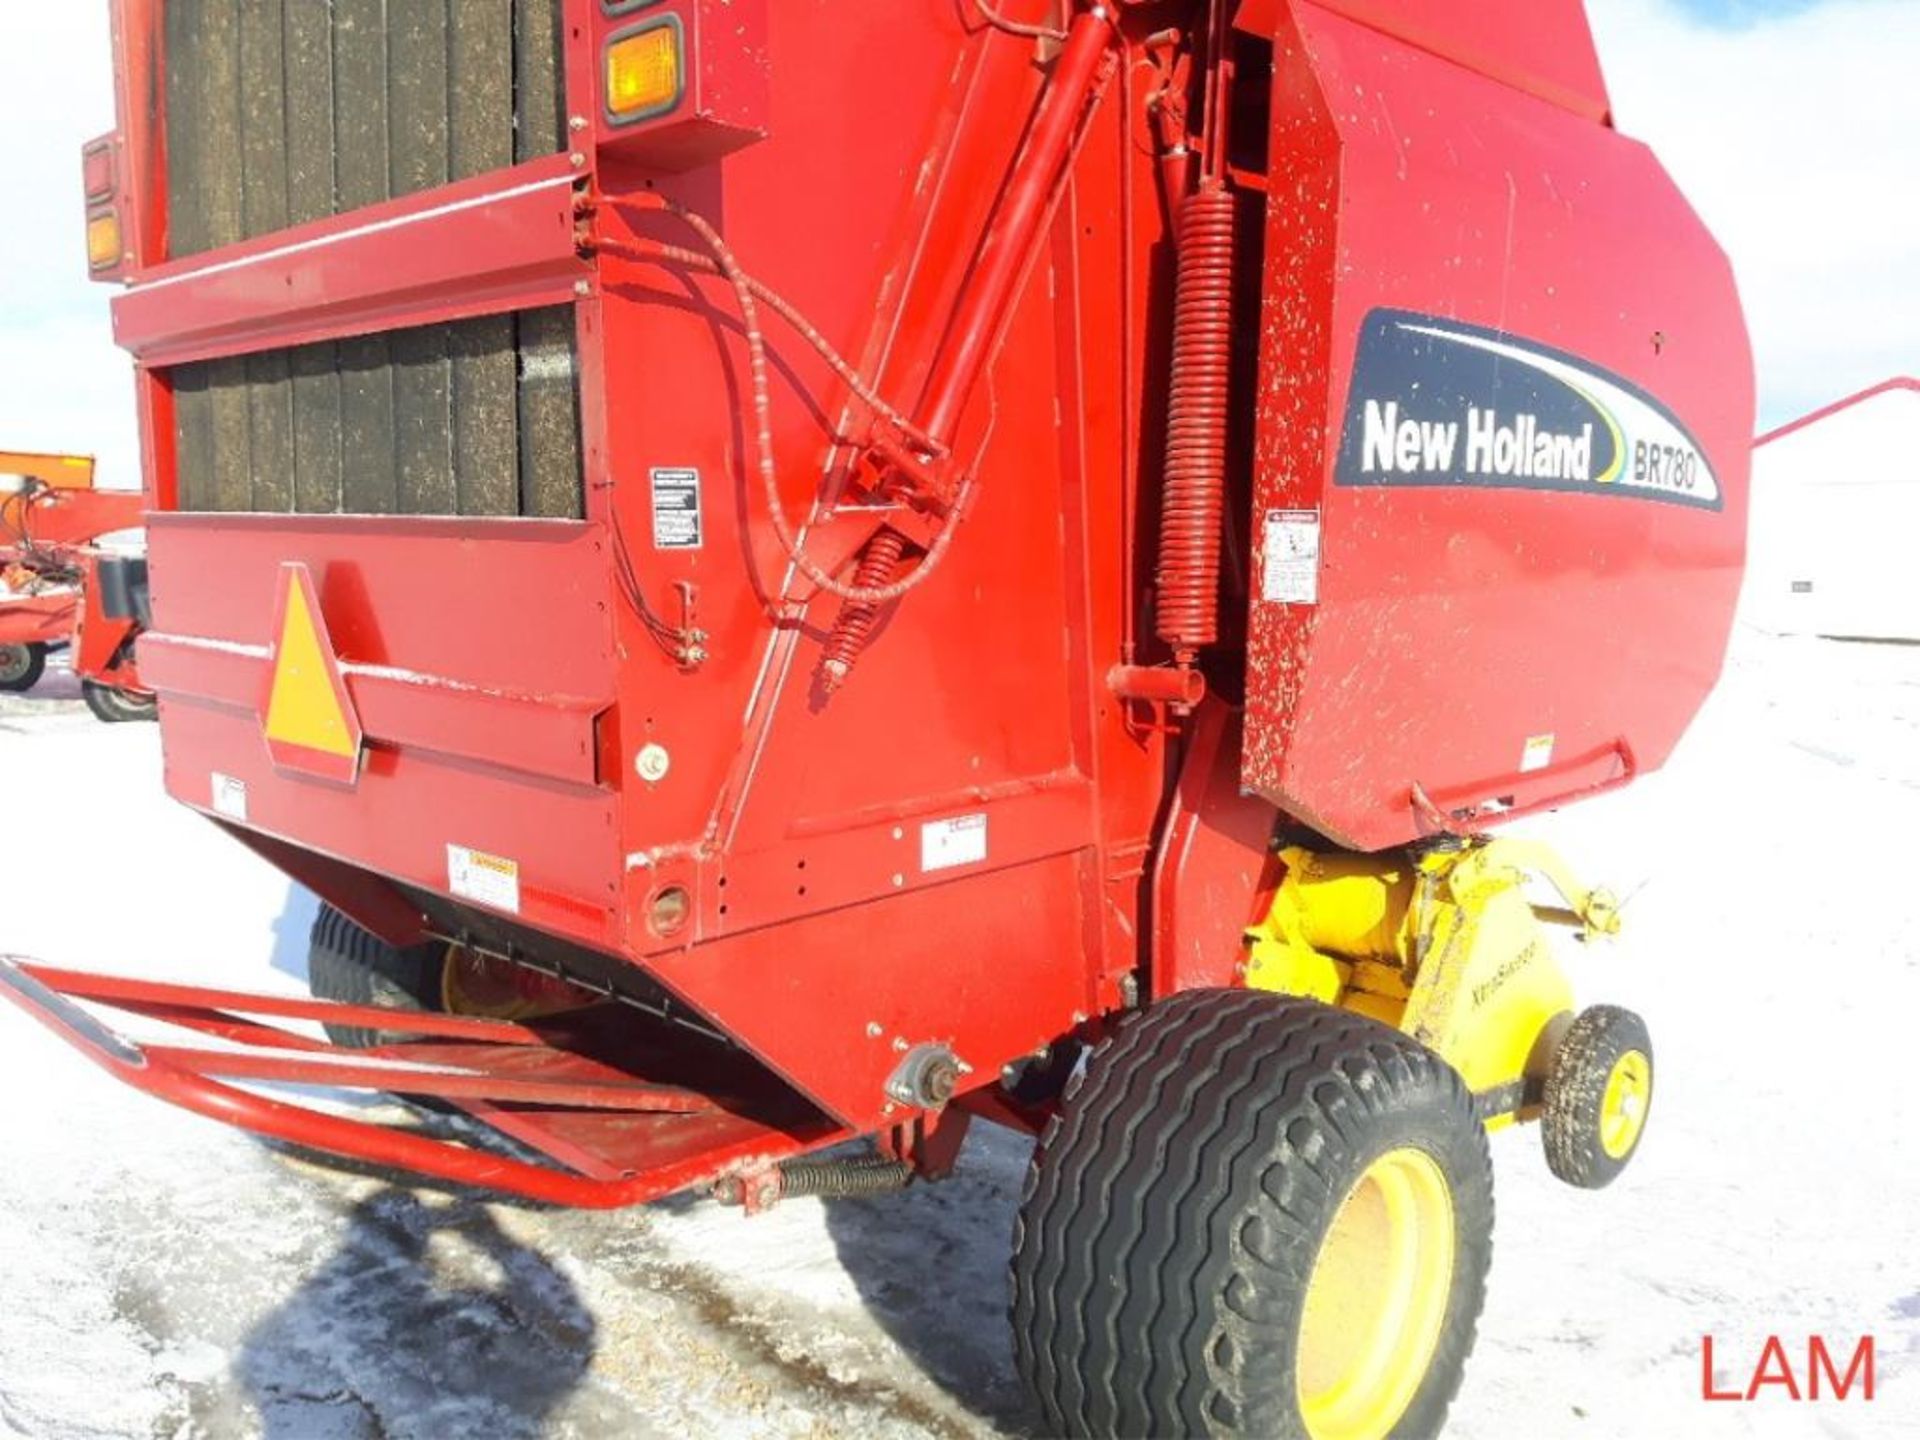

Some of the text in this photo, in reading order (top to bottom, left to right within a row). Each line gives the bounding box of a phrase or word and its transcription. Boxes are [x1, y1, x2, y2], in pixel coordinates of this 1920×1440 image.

[1362, 399, 1592, 481] New Holland
[1634, 441, 1695, 489] BR780
